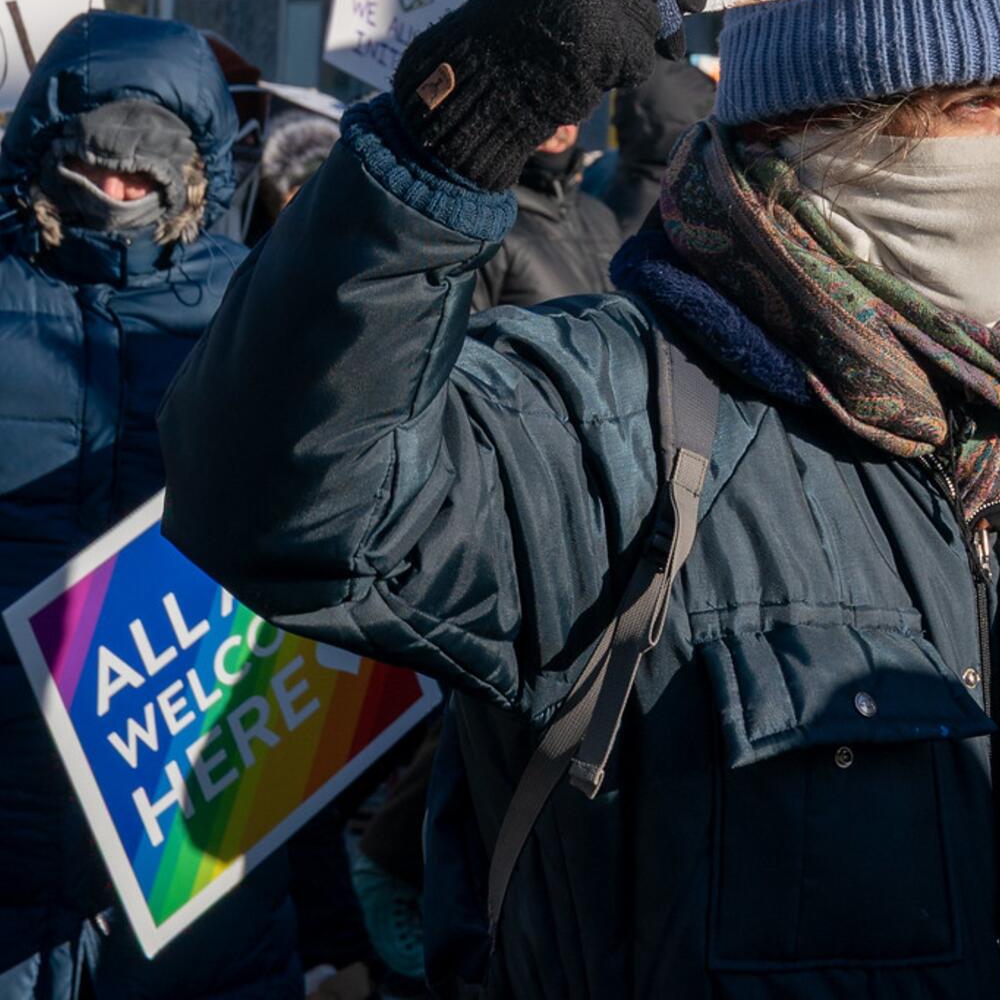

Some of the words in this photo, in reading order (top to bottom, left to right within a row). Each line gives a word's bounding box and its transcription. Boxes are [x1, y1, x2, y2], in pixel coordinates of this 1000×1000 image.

[97, 591, 210, 716] ALL
[107, 613, 286, 769] WELCO
[131, 654, 321, 848] HERE
